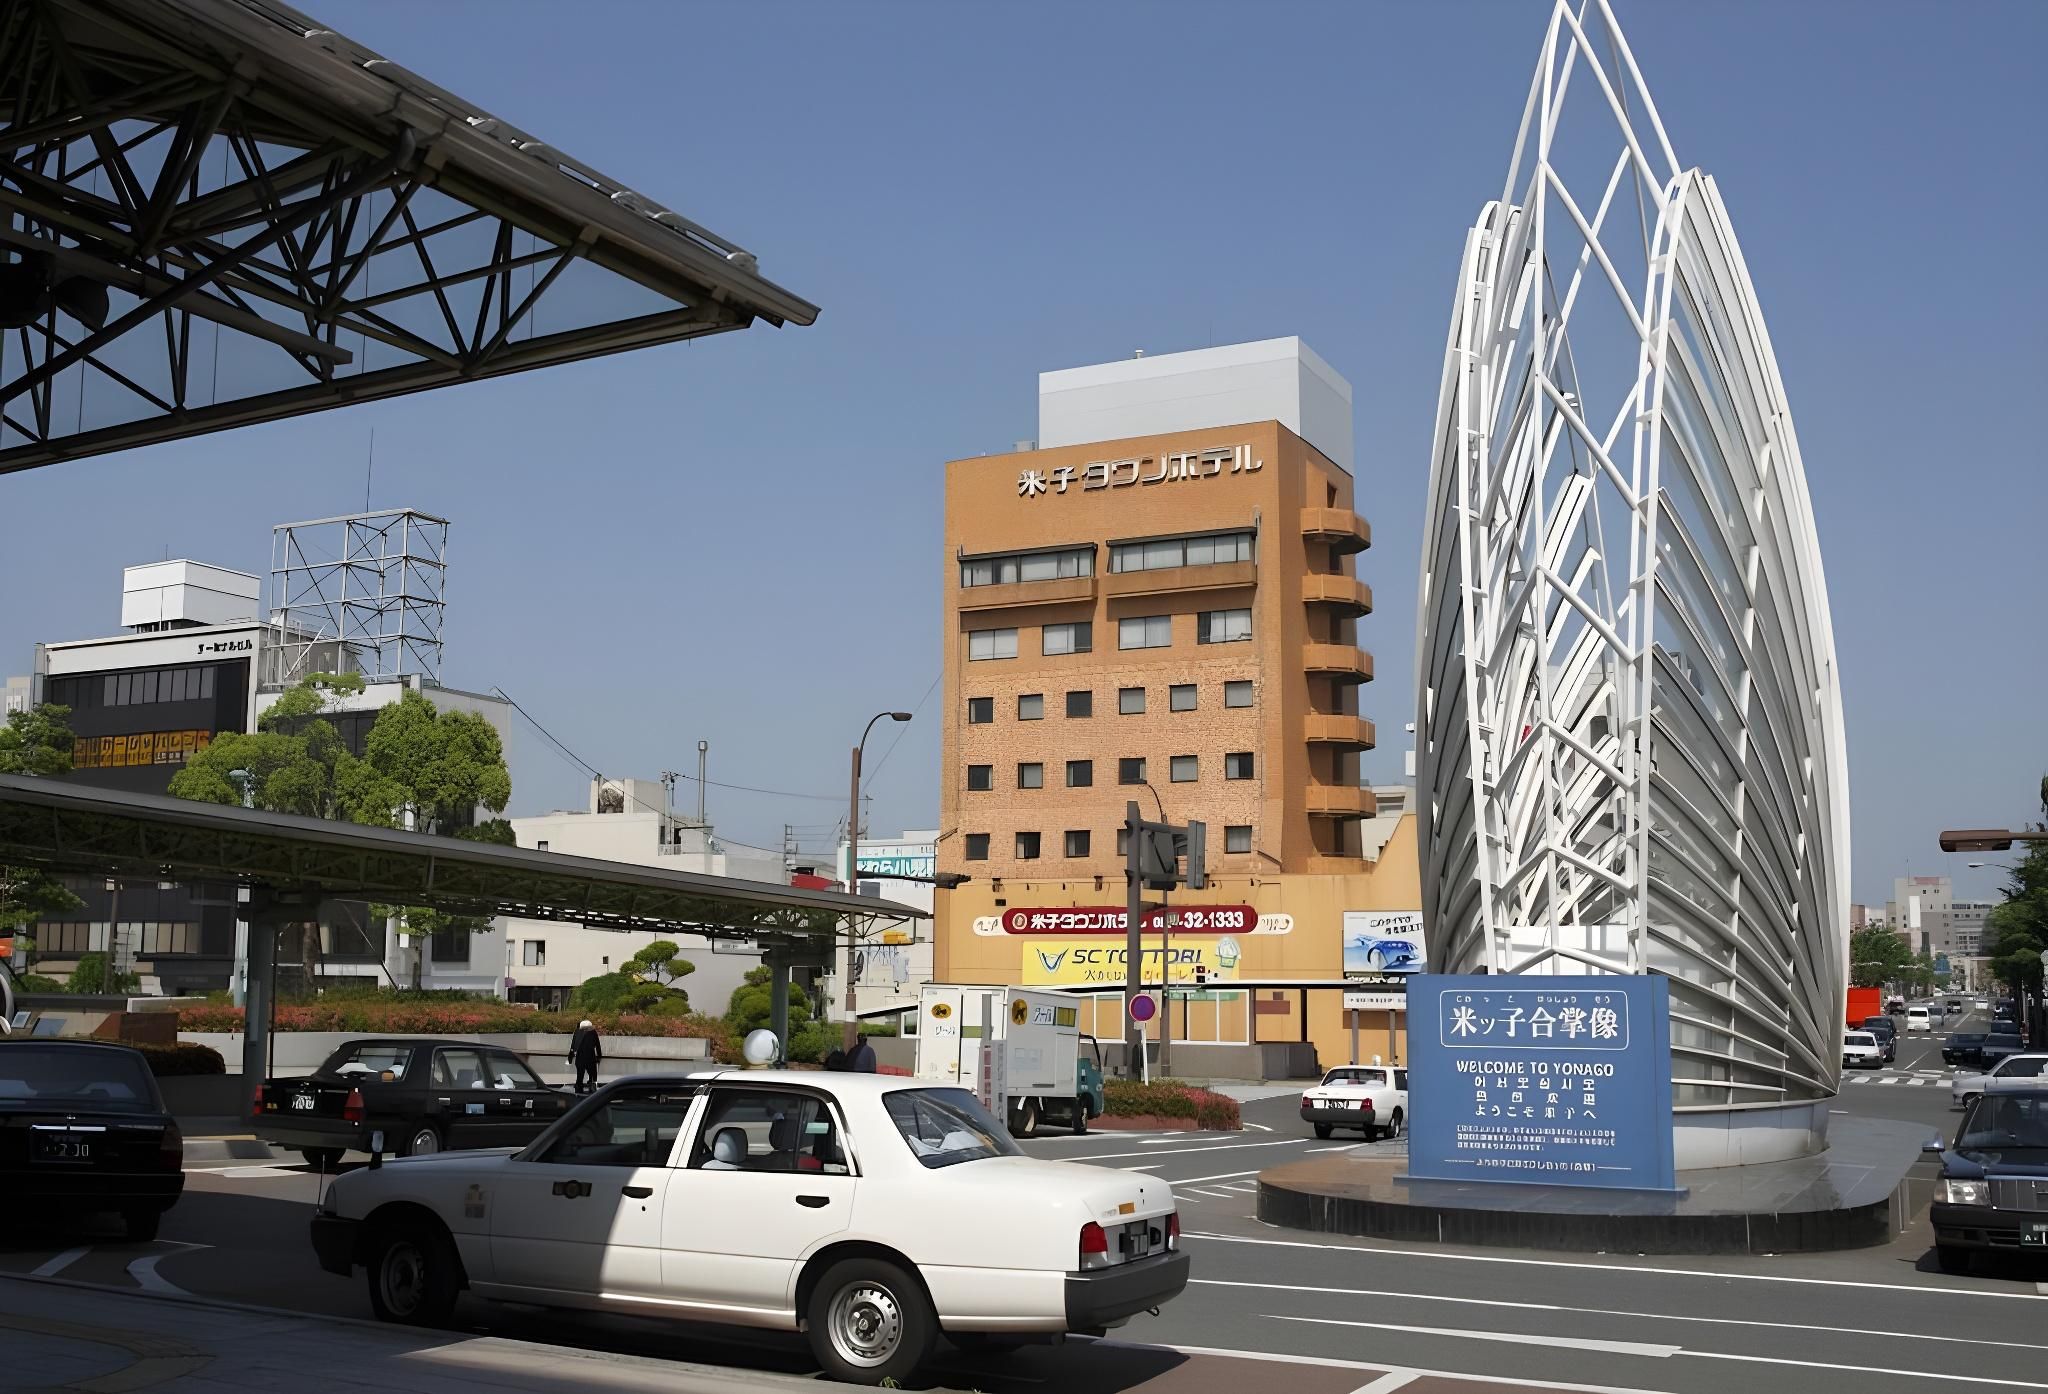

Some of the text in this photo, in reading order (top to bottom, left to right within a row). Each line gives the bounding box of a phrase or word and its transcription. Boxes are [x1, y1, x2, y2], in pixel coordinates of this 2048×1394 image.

[1018, 444, 1263, 498] 米子タウンホテル
[1456, 1060, 1614, 1077] WELCOME TO YONAGO
